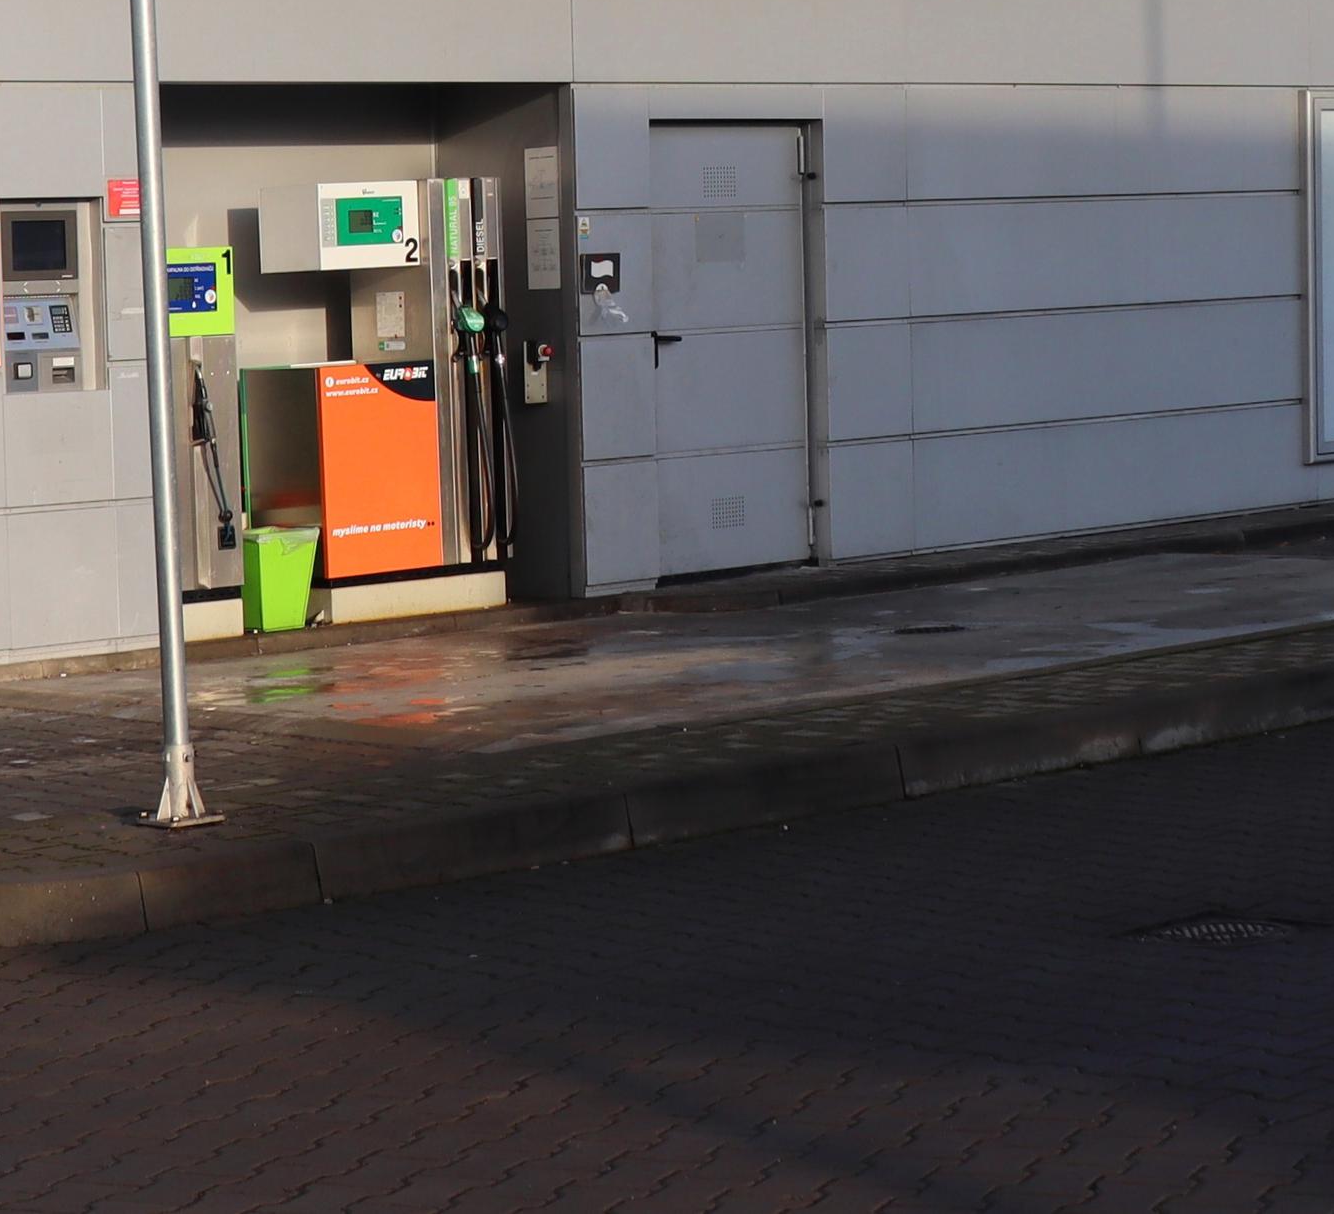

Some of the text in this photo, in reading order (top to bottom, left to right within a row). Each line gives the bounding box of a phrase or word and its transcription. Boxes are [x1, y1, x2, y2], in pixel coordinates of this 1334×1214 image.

[449, 210, 459, 254] NATURAL
[475, 218, 485, 253] DIESEL
[221, 249, 231, 275] 1
[405, 238, 419, 263] 2
[325, 387, 379, 397] www.eurobit.cz
[335, 376, 369, 385] eurobit.cz
[370, 524, 381, 533] na
